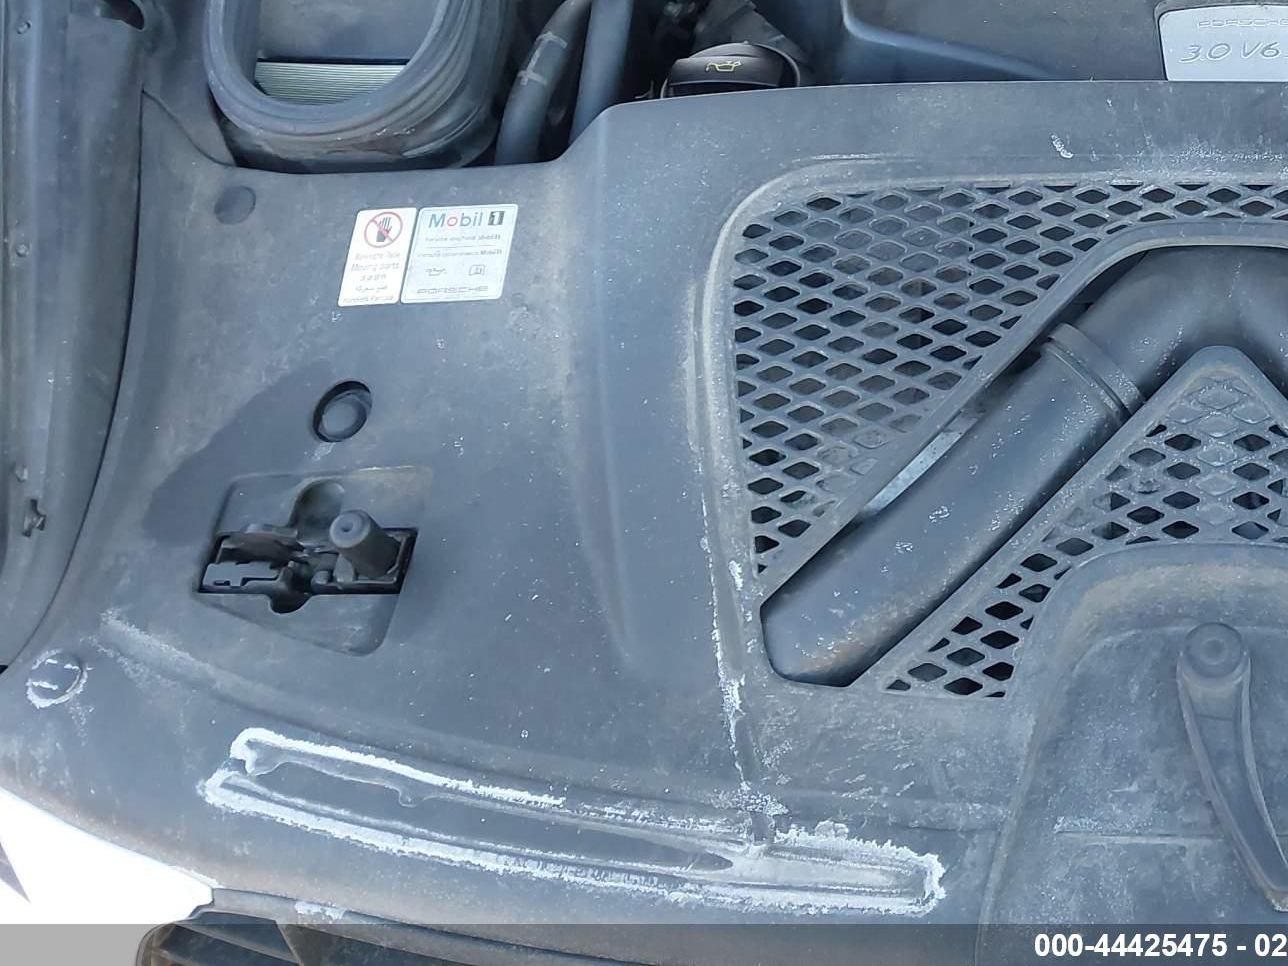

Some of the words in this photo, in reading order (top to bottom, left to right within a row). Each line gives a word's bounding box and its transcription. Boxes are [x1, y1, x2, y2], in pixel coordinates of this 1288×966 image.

[1240, 41, 1281, 59] V6
[428, 212, 483, 229] Mobil
[488, 211, 505, 226] 1
